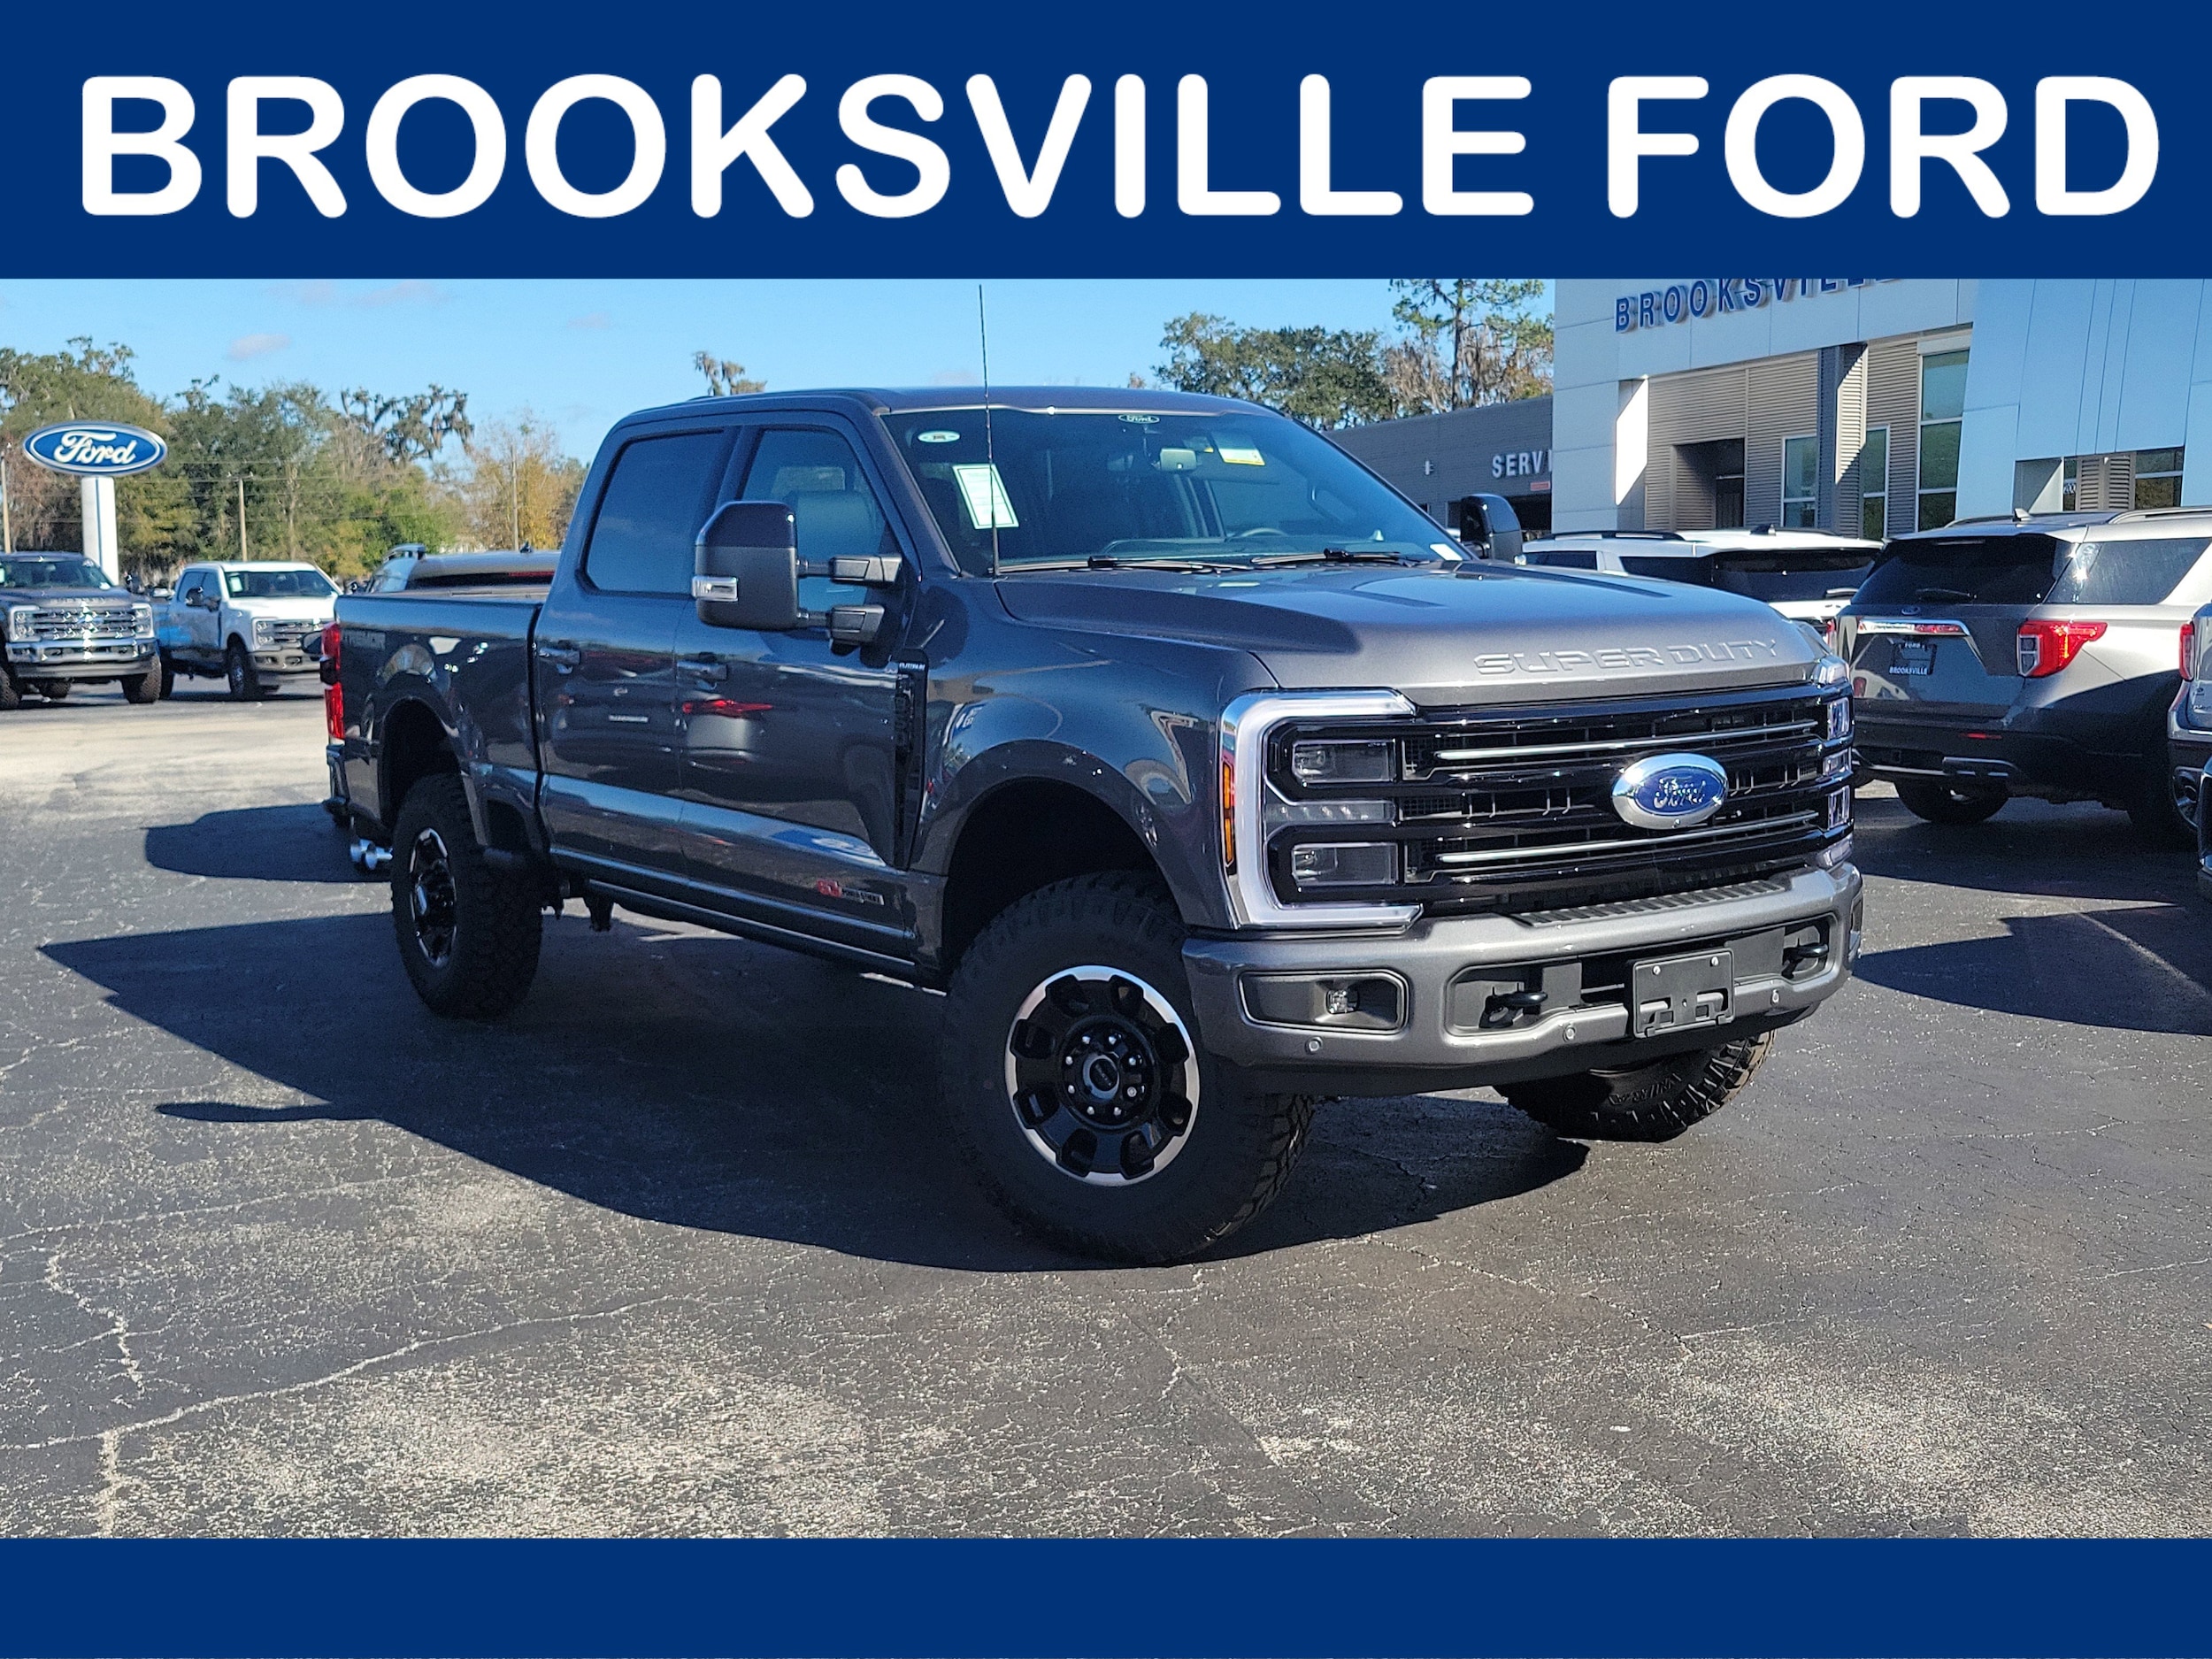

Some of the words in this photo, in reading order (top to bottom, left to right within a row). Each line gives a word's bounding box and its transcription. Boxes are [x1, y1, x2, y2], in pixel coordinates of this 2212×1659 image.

[1615, 279, 1900, 333] BROOKSV
[53, 430, 137, 465] Ford
[1473, 648, 1664, 675] SUPER
[1667, 639, 1778, 664] DUTY
[1653, 775, 1707, 809] Ford
